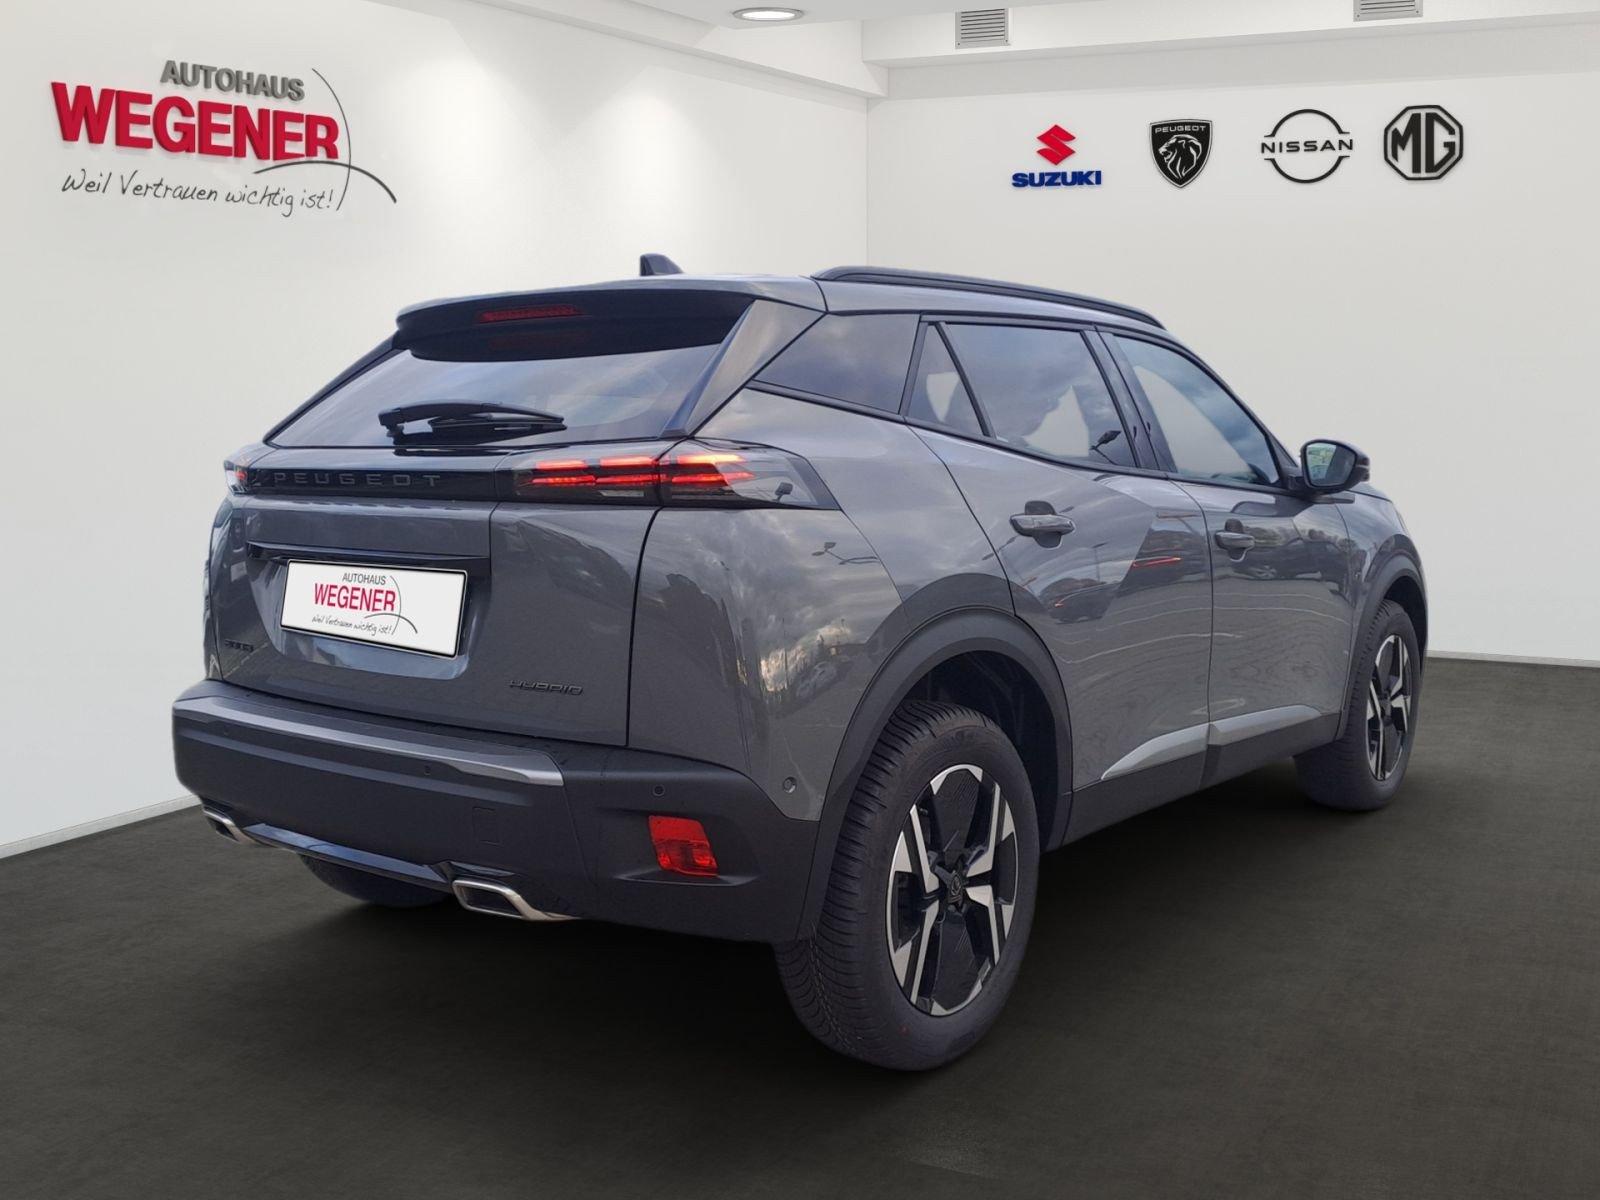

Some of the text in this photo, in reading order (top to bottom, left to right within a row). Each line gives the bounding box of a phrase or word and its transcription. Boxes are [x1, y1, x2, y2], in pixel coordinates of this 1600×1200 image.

[160, 60, 305, 101] AUTOHAUS
[51, 81, 340, 161] WEGENER
[1155, 125, 1206, 133] PEUGEOT
[1261, 139, 1353, 153] NISSAN
[1391, 112, 1456, 174] MG
[1012, 170, 1102, 188] SUZUKI
[62, 168, 333, 217] Weil Vertrauen wichtig ist!
[273, 472, 441, 487] PEUGEOT
[342, 572, 386, 585] AUTOHAUS
[314, 583, 396, 612] WEGENER
[509, 679, 584, 696] HYBRID
